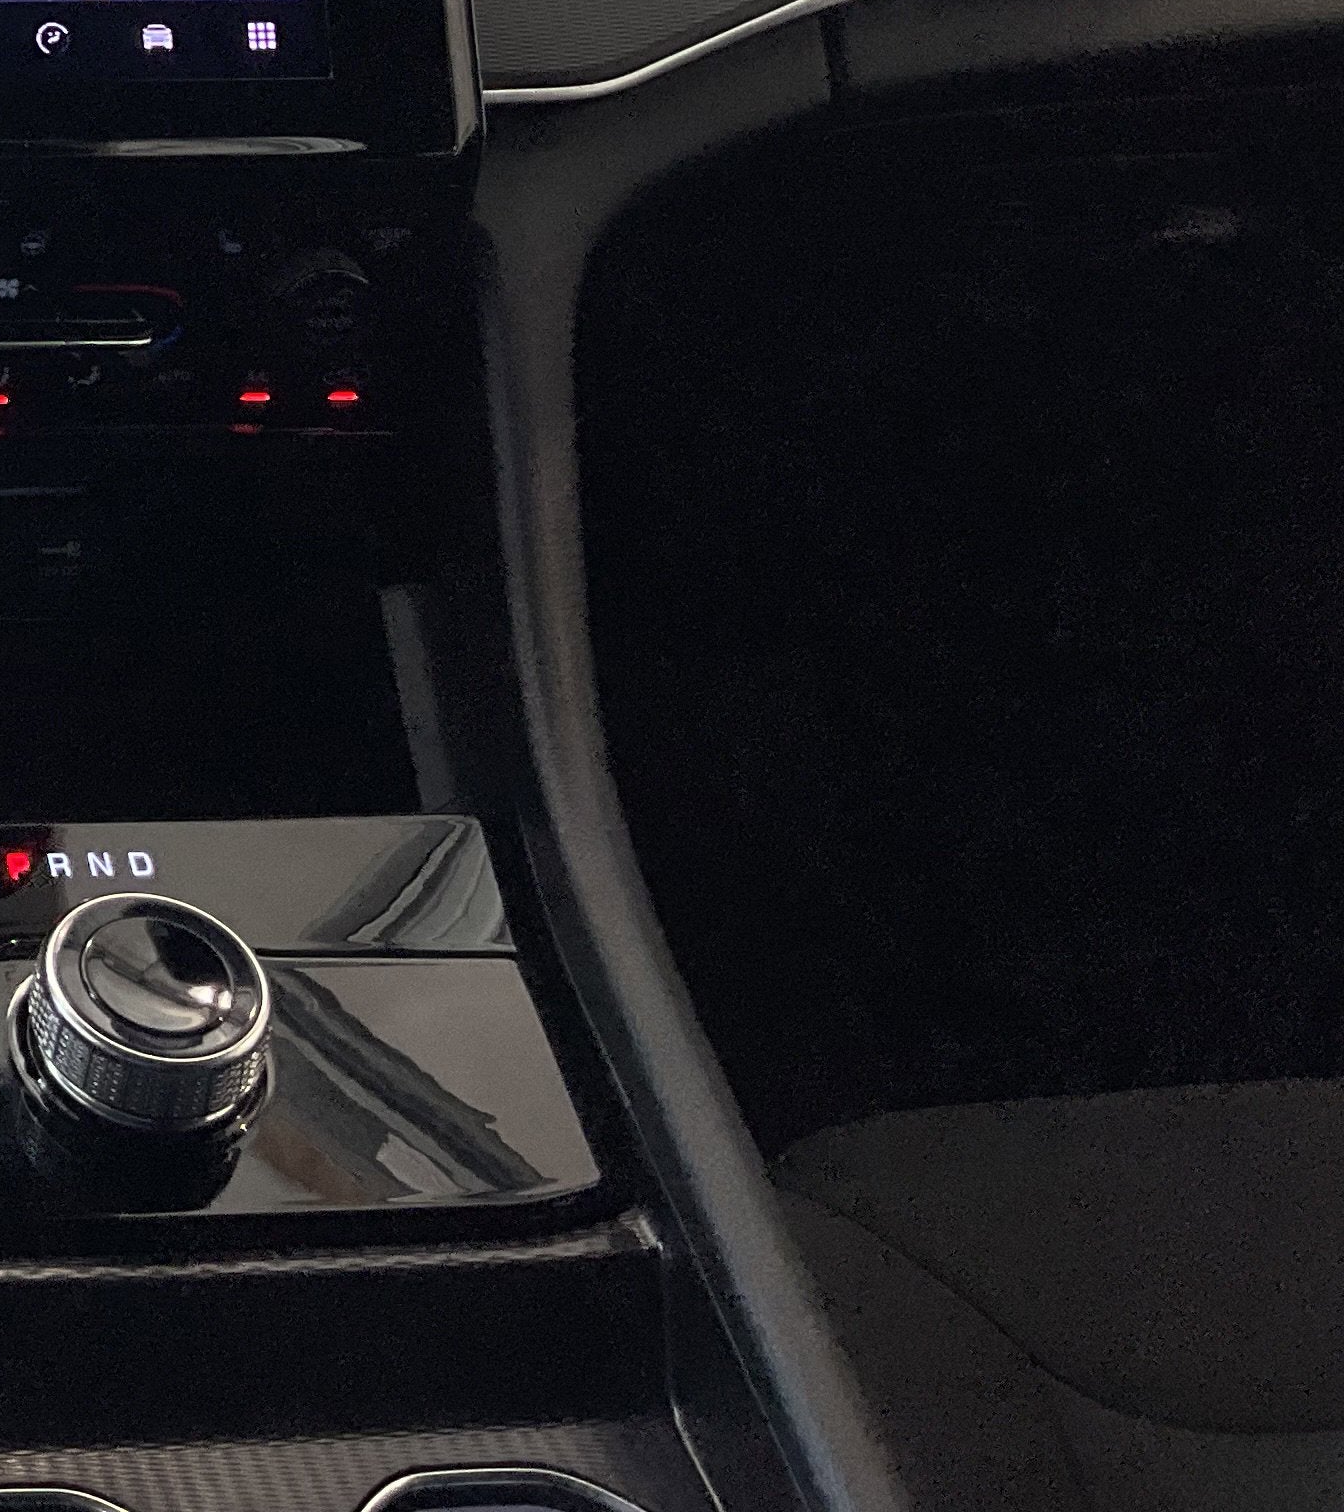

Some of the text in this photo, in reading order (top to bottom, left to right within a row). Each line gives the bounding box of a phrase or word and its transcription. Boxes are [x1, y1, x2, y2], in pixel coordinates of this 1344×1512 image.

[6, 851, 154, 880] P R N D
